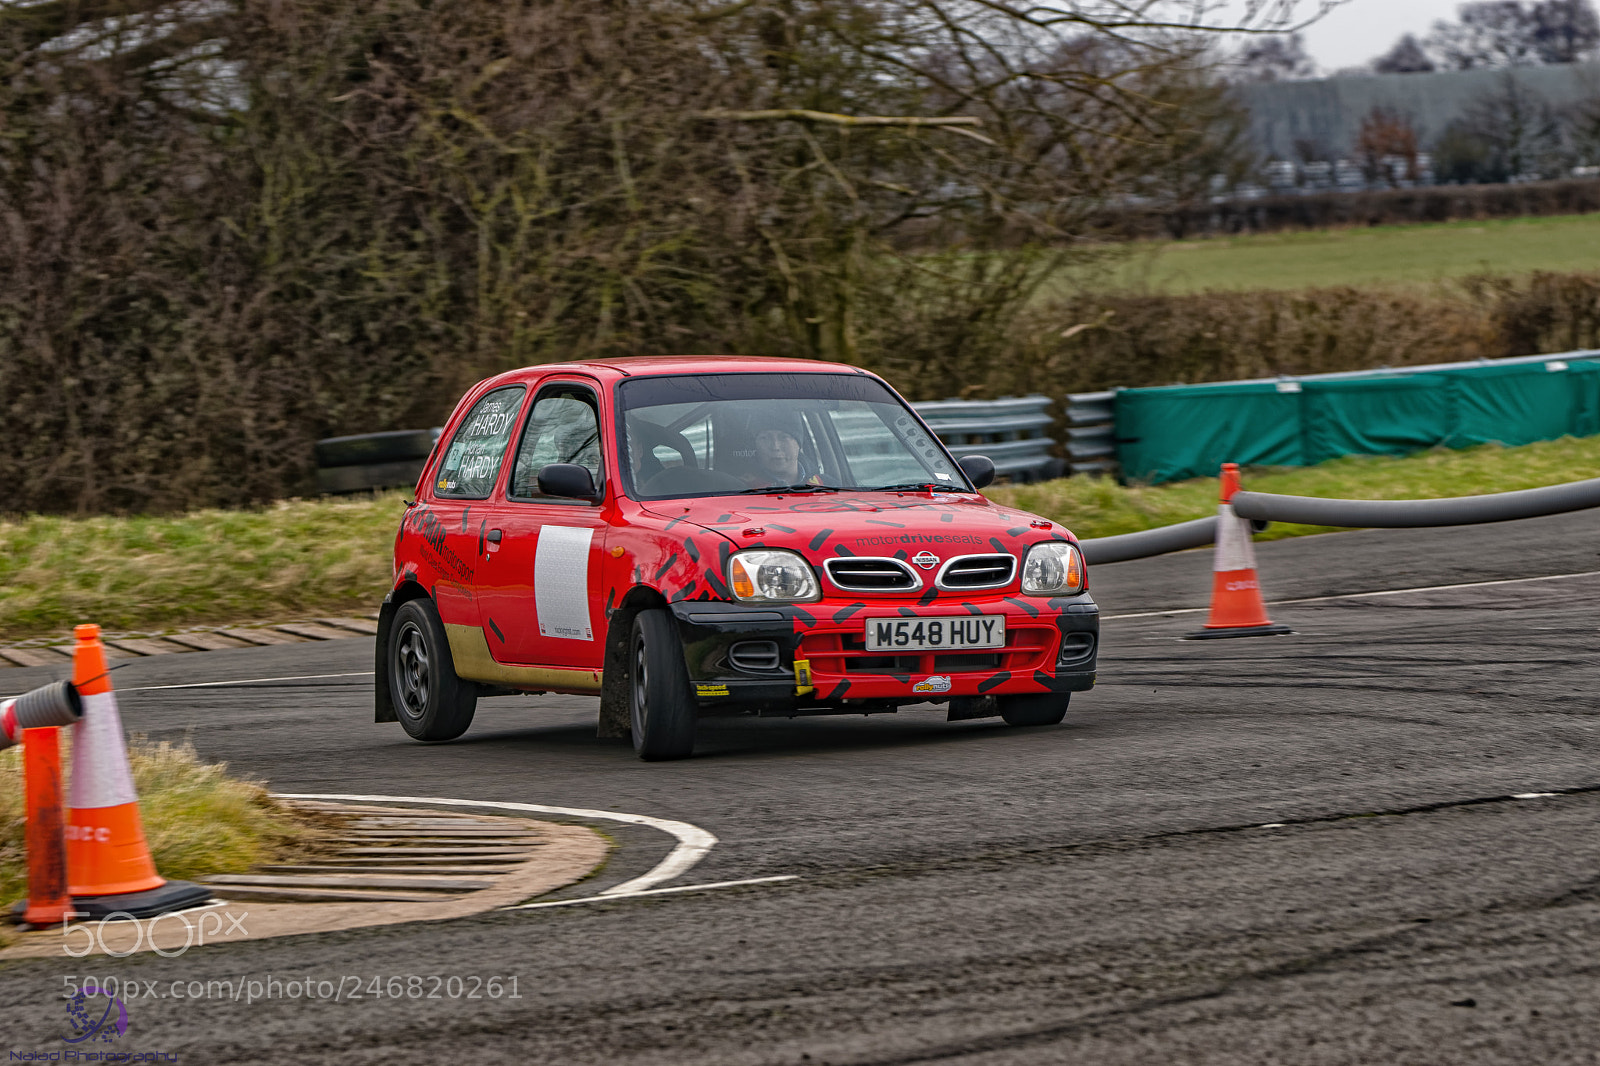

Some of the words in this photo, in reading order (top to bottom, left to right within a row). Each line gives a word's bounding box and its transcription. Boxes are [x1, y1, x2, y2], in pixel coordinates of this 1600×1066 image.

[480, 400, 502, 413] James
[471, 413, 514, 436] HARDY
[458, 455, 499, 479] HARDY
[856, 533, 983, 547] motordriveseats
[915, 556, 938, 564] NISSAN
[877, 621, 942, 646] M548
[951, 620, 995, 645] HUY
